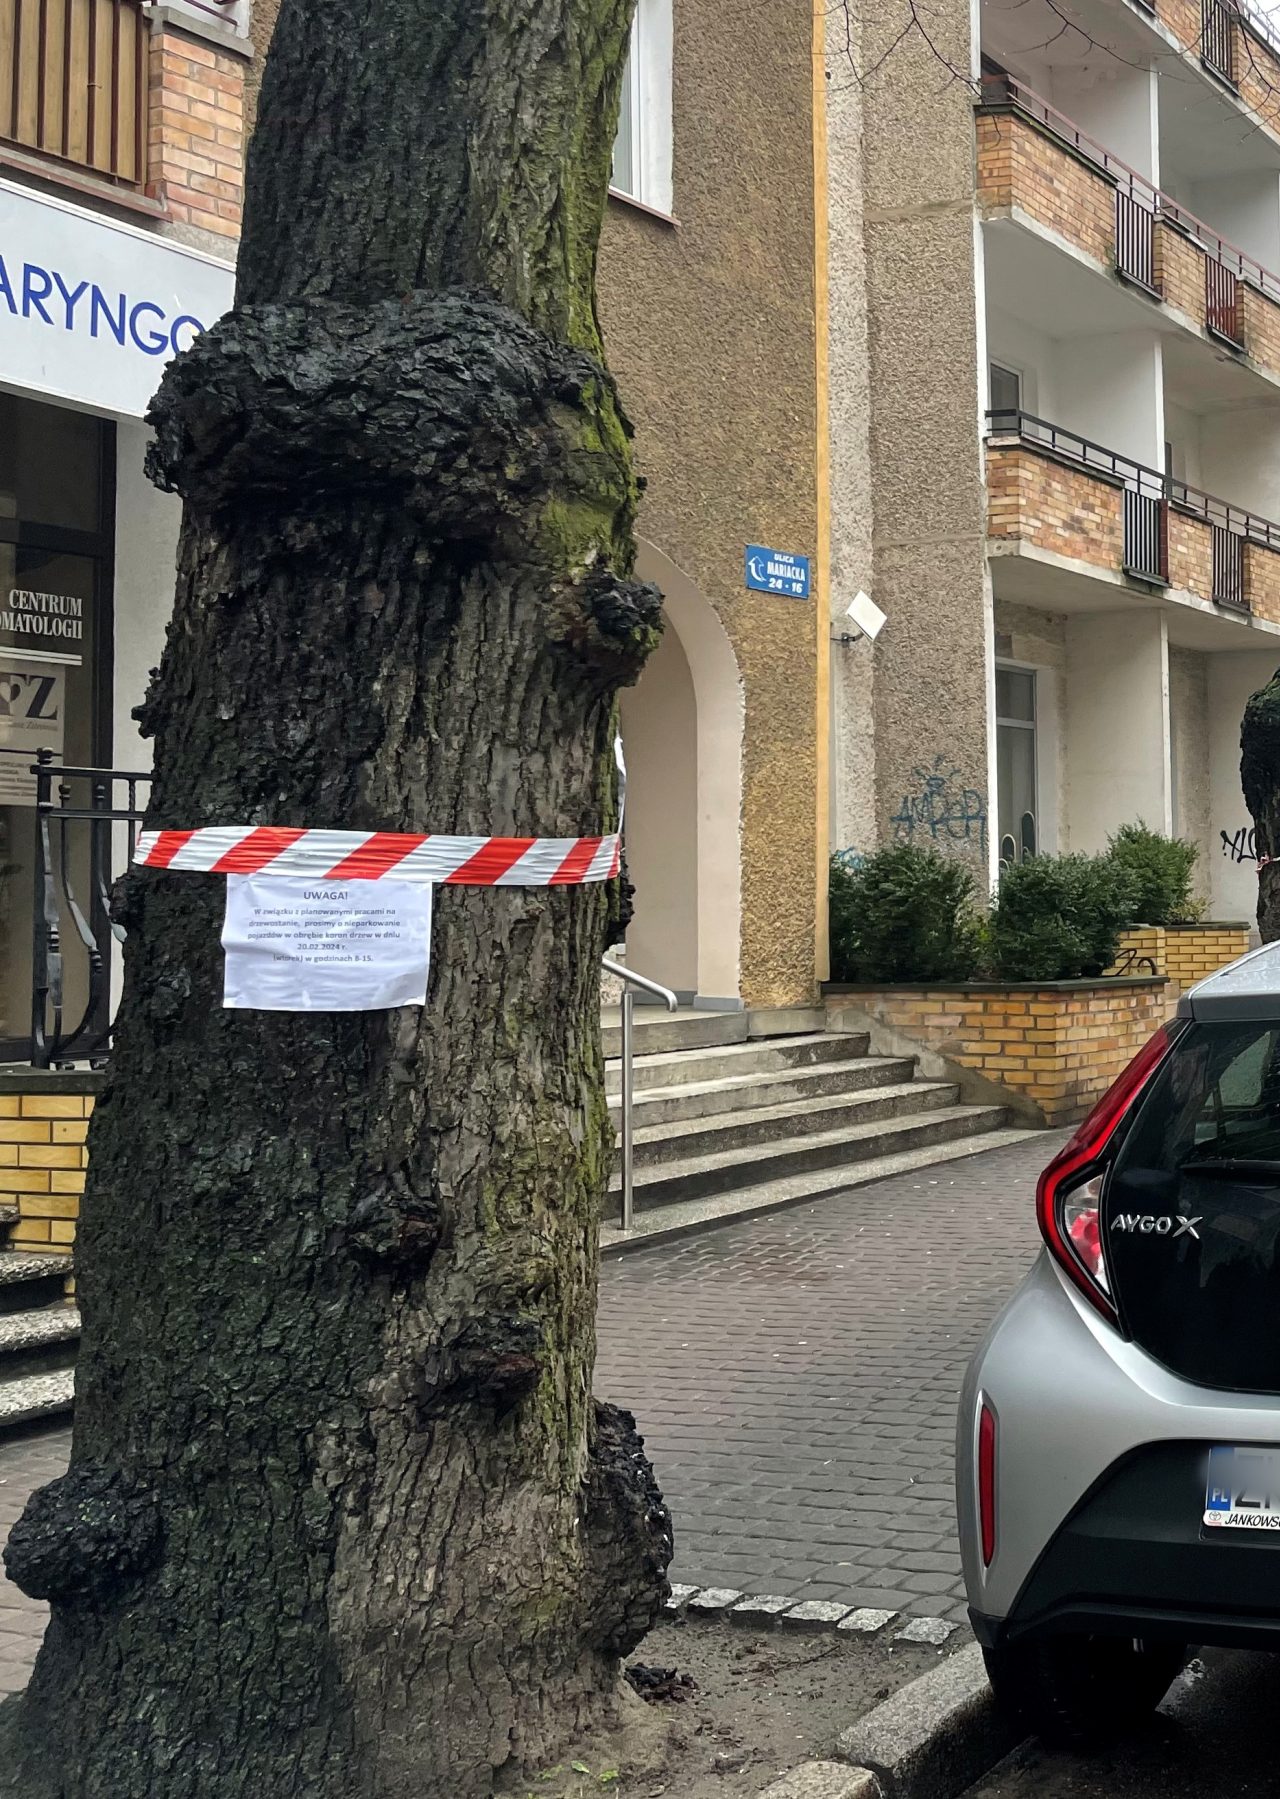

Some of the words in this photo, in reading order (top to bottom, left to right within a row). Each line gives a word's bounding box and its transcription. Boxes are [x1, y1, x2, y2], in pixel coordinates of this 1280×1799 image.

[774, 553, 795, 564] ULICA
[766, 561, 806, 582] MARIACKA
[768, 577, 783, 590] 24
[791, 582, 804, 594] 16
[9, 589, 82, 617] CENTRUM
[0, 611, 82, 639] MATOLOGII
[303, 891, 348, 900] UWAGA!
[263, 908, 294, 916] związku
[301, 908, 353, 916] planowanymi
[354, 908, 385, 916] pracami
[344, 920, 401, 928] nieparkowanie
[247, 932, 283, 940] pojazdów
[293, 932, 324, 940] obrębie
[383, 931, 401, 939] dniu
[297, 943, 340, 951] 20.02.2024
[314, 954, 353, 964] godzinach
[1110, 1213, 1172, 1234] AYGO
[1172, 1214, 1204, 1240] X
